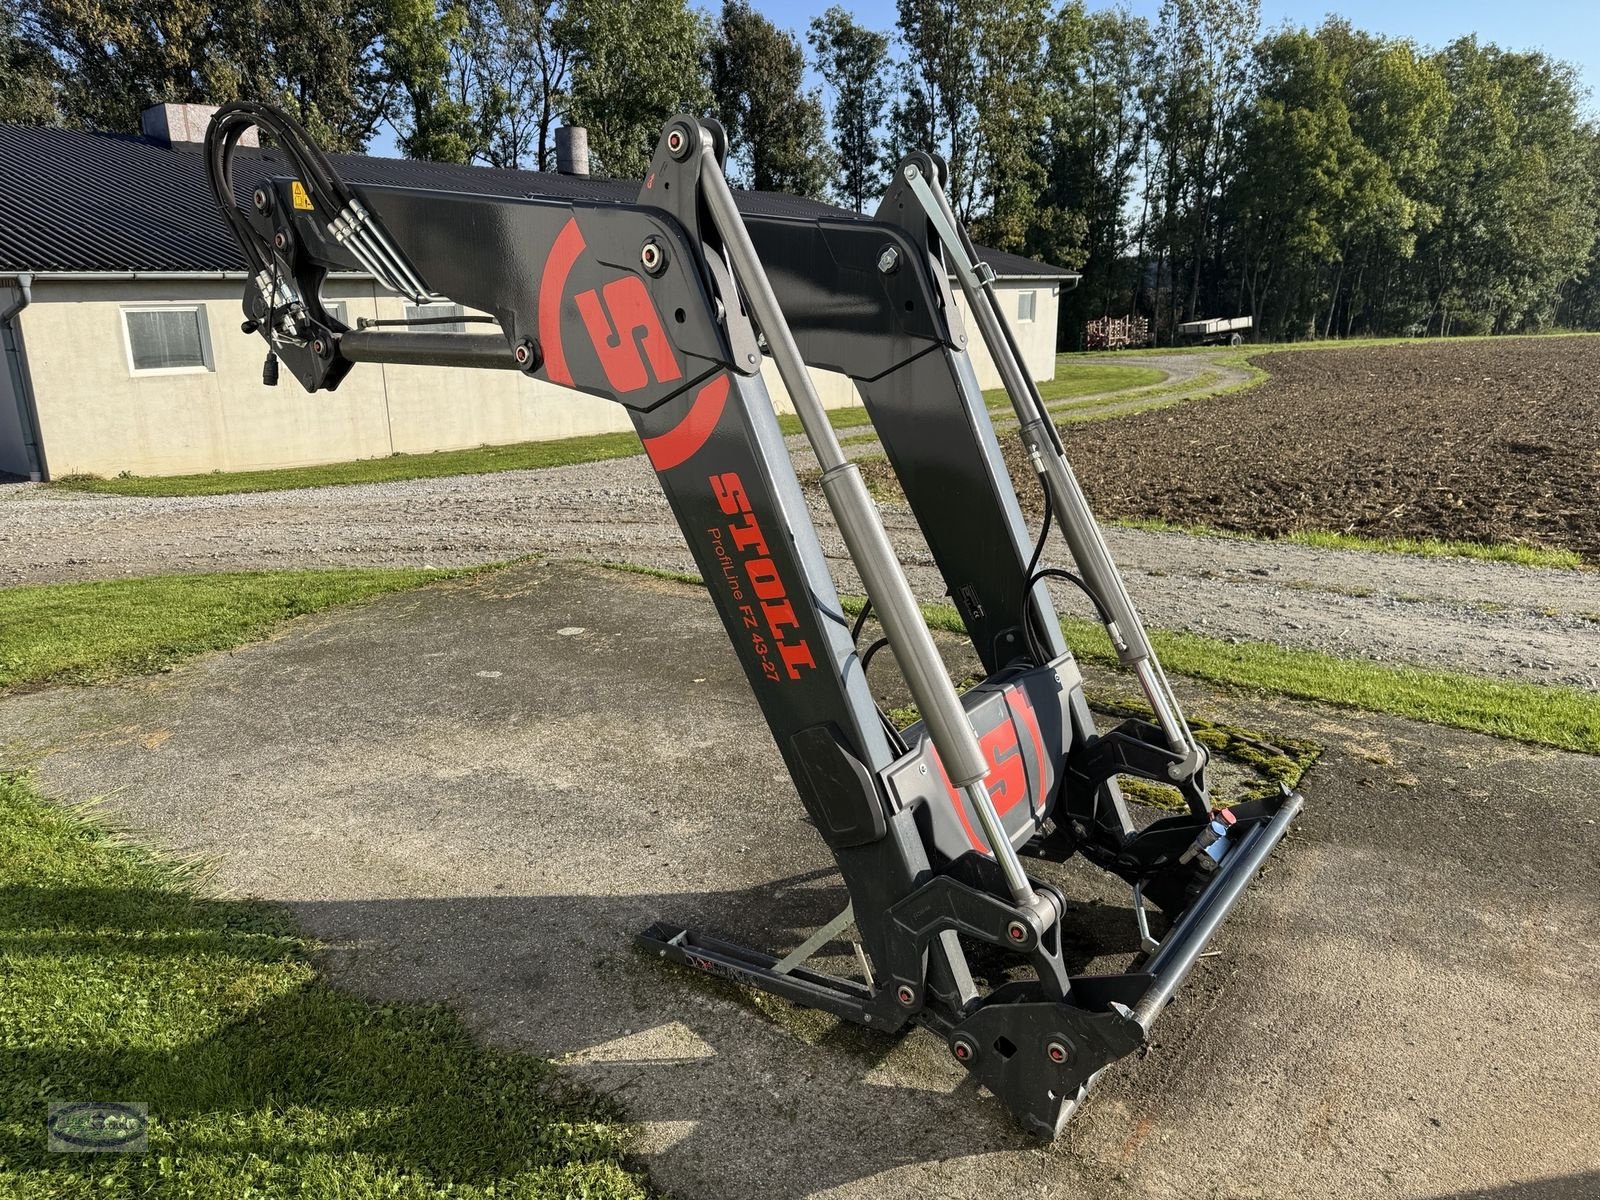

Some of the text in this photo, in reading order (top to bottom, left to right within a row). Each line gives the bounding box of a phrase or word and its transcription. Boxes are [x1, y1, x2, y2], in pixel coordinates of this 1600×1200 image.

[574, 275, 682, 393] S
[708, 528, 780, 682] ProfiLine FZ 43-27
[709, 472, 816, 680] STOLL
